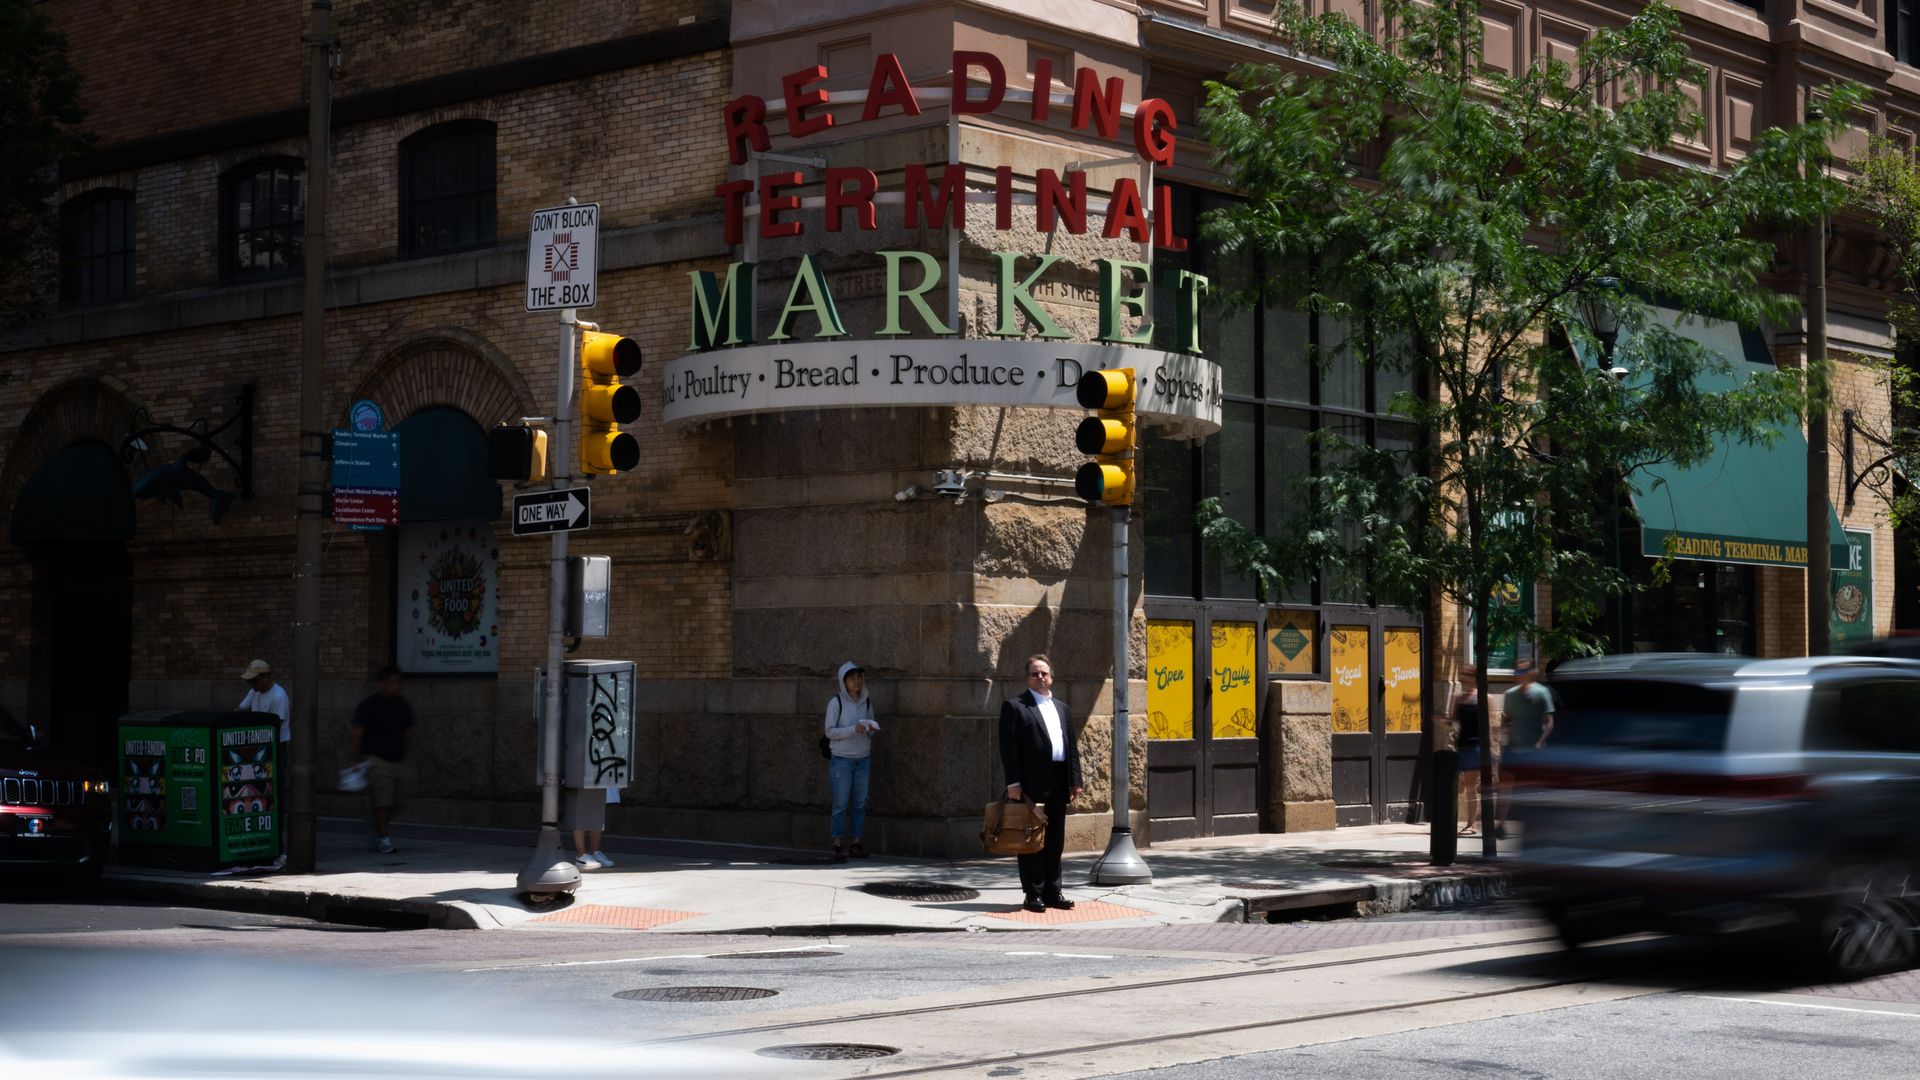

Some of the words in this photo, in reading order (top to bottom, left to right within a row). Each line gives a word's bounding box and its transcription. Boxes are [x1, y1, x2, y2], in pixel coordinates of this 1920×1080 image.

[723, 50, 1179, 169] READING
[562, 209, 594, 229] BLOCK
[715, 163, 1188, 252] TERMINAL
[835, 273, 883, 293] STREE
[1061, 282, 1100, 303] STREE
[531, 286, 556, 306] THE
[563, 284, 590, 304] BOX
[687, 250, 1209, 354] MARKET
[684, 364, 751, 400] Poultry
[775, 354, 860, 390] Bread
[889, 354, 1024, 388] Produce
[1155, 366, 1204, 403] Spices
[522, 506, 542, 522] ONE
[546, 503, 567, 519] WAY
[1673, 537, 1721, 557] EADING
[1724, 541, 1783, 561] TERMINAL
[1785, 546, 1809, 564] MAR
[1849, 545, 1862, 570] KE
[440, 579, 474, 593] UNITED
[444, 600, 469, 612] FOOD
[1154, 666, 1184, 690] Open
[1215, 666, 1250, 692] Daily
[1336, 664, 1362, 687] Local
[223, 731, 245, 746] UNITED
[247, 729, 273, 744] FANDOM
